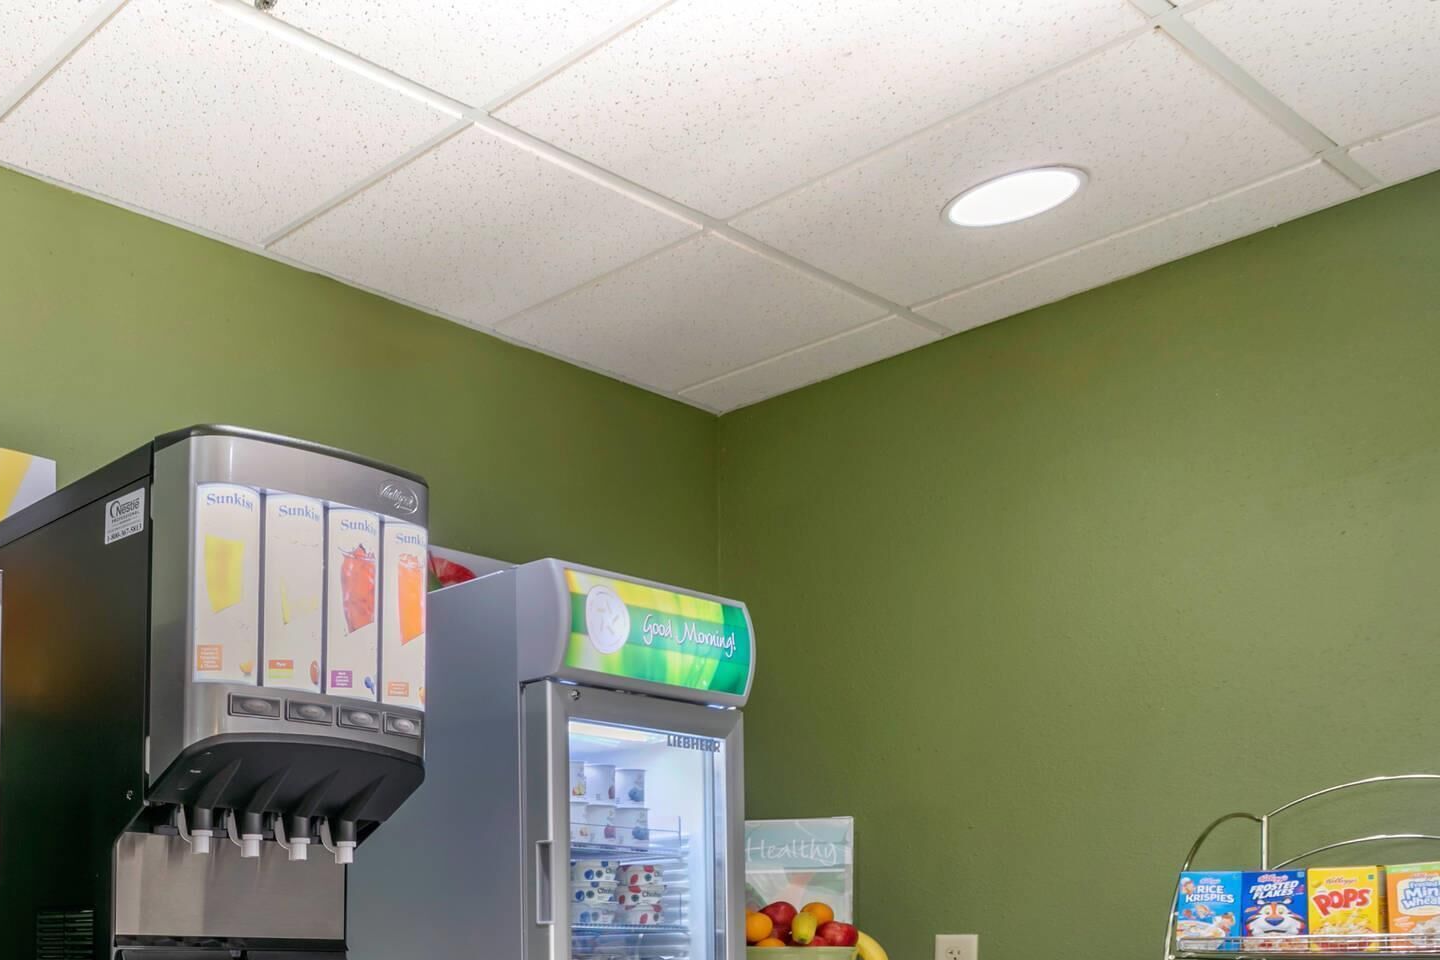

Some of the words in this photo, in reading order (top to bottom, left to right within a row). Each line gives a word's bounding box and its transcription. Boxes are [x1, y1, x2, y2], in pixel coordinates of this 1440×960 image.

[643, 614, 673, 645] Good
[674, 623, 736, 658] Morning!
[667, 735, 721, 752] LIEBHERR
[744, 837, 837, 867] Healthy
[1197, 885, 1225, 894] RICE
[1249, 880, 1299, 894] FROSTED
[1252, 889, 1294, 900] FLAKES
[1185, 893, 1235, 903] KRISPIES
[1312, 888, 1371, 917] POPS
